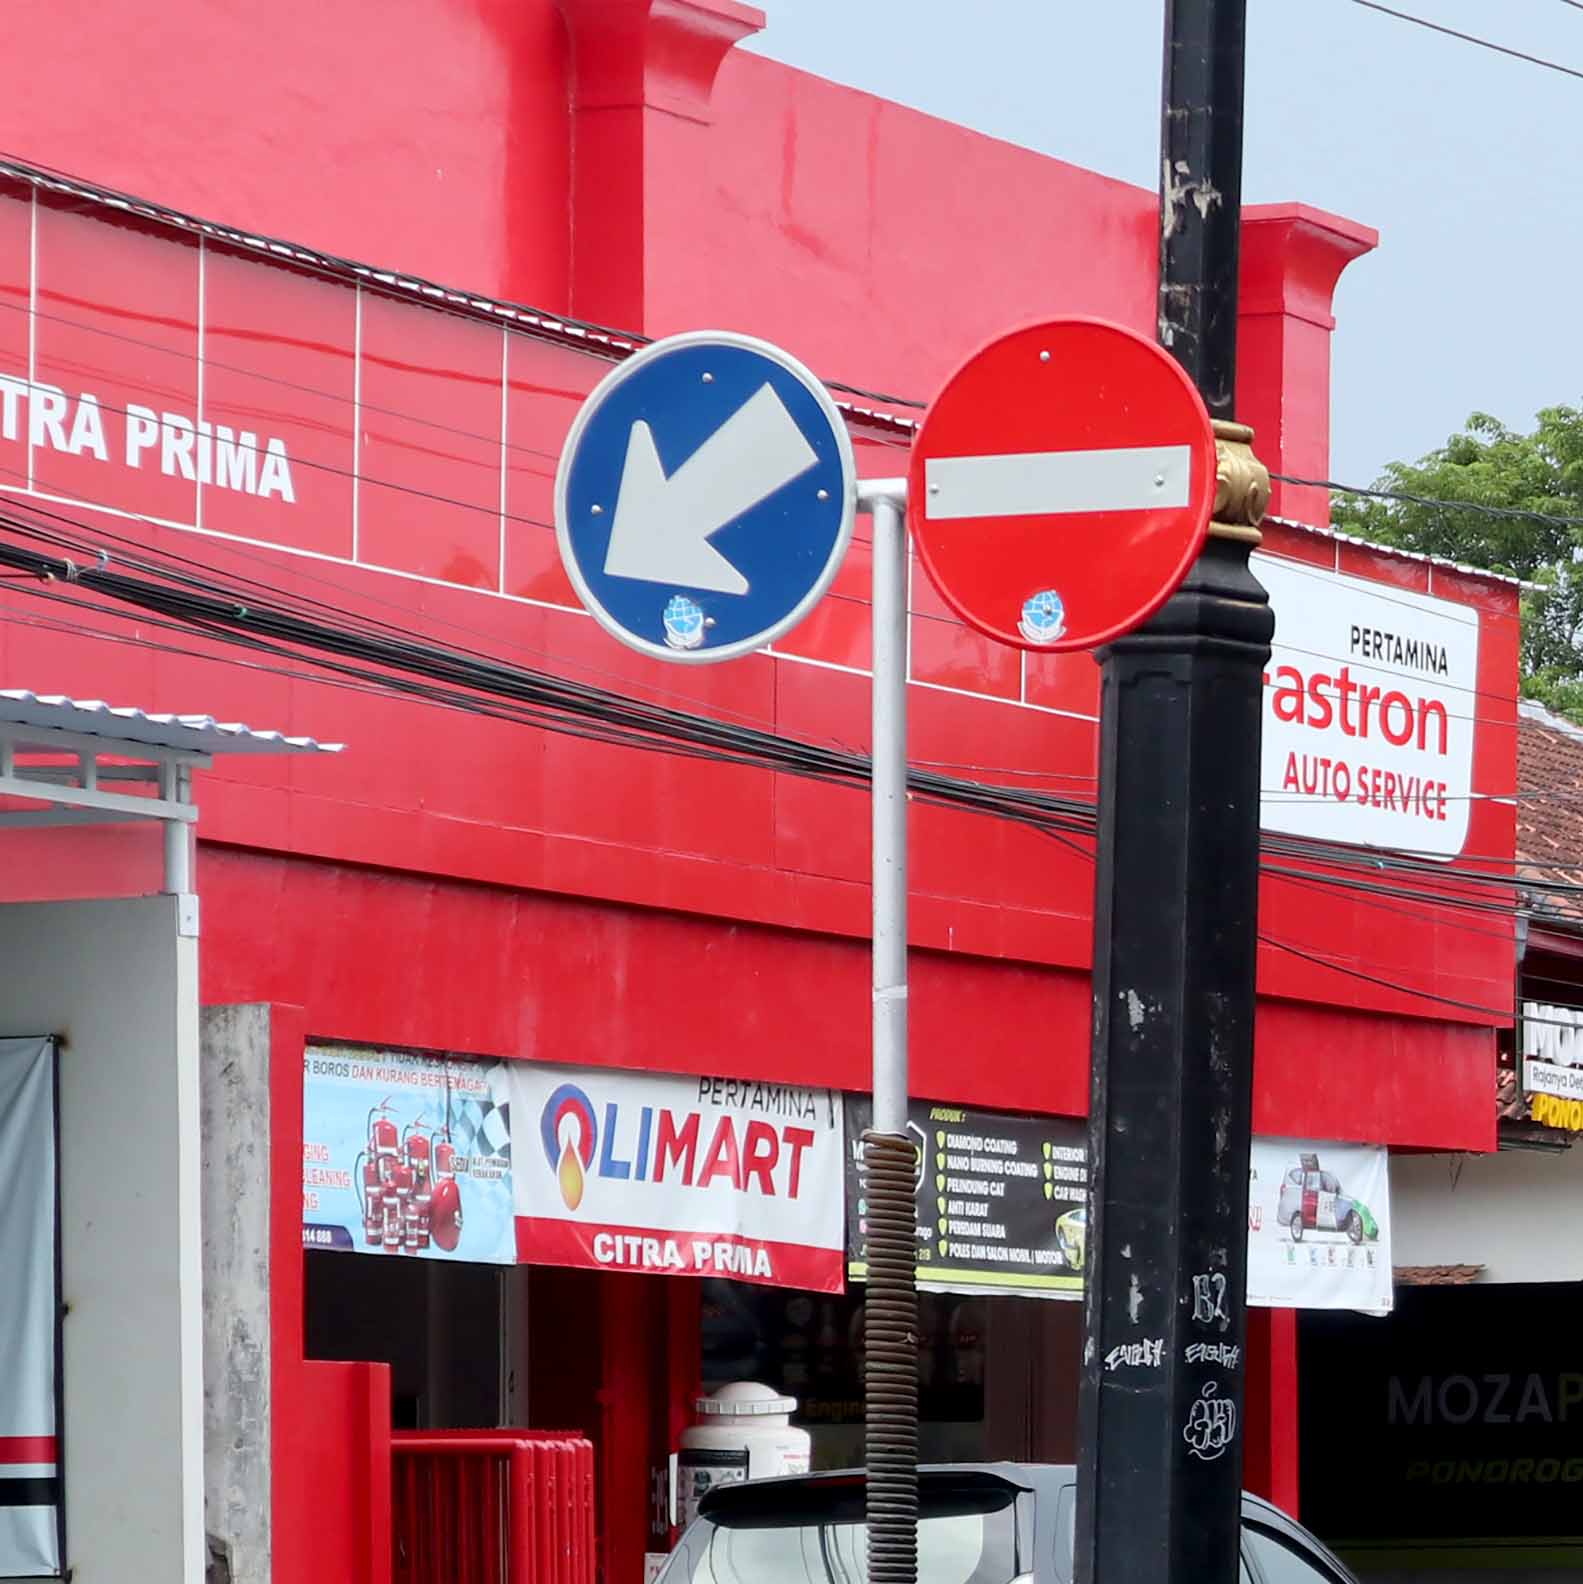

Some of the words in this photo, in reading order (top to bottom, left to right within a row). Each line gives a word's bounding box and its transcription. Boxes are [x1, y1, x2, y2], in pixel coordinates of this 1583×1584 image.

[126, 403, 297, 503] PRIMA
[1350, 624, 1449, 676] PERTAMINA
[1263, 664, 1448, 755] astron
[1283, 751, 1351, 801] AUTO
[1356, 765, 1448, 821] SERVICE
[698, 1076, 817, 1120] PERTAMINA
[1532, 1066, 1567, 1090] Rajanya
[593, 1231, 685, 1270] CITRA
